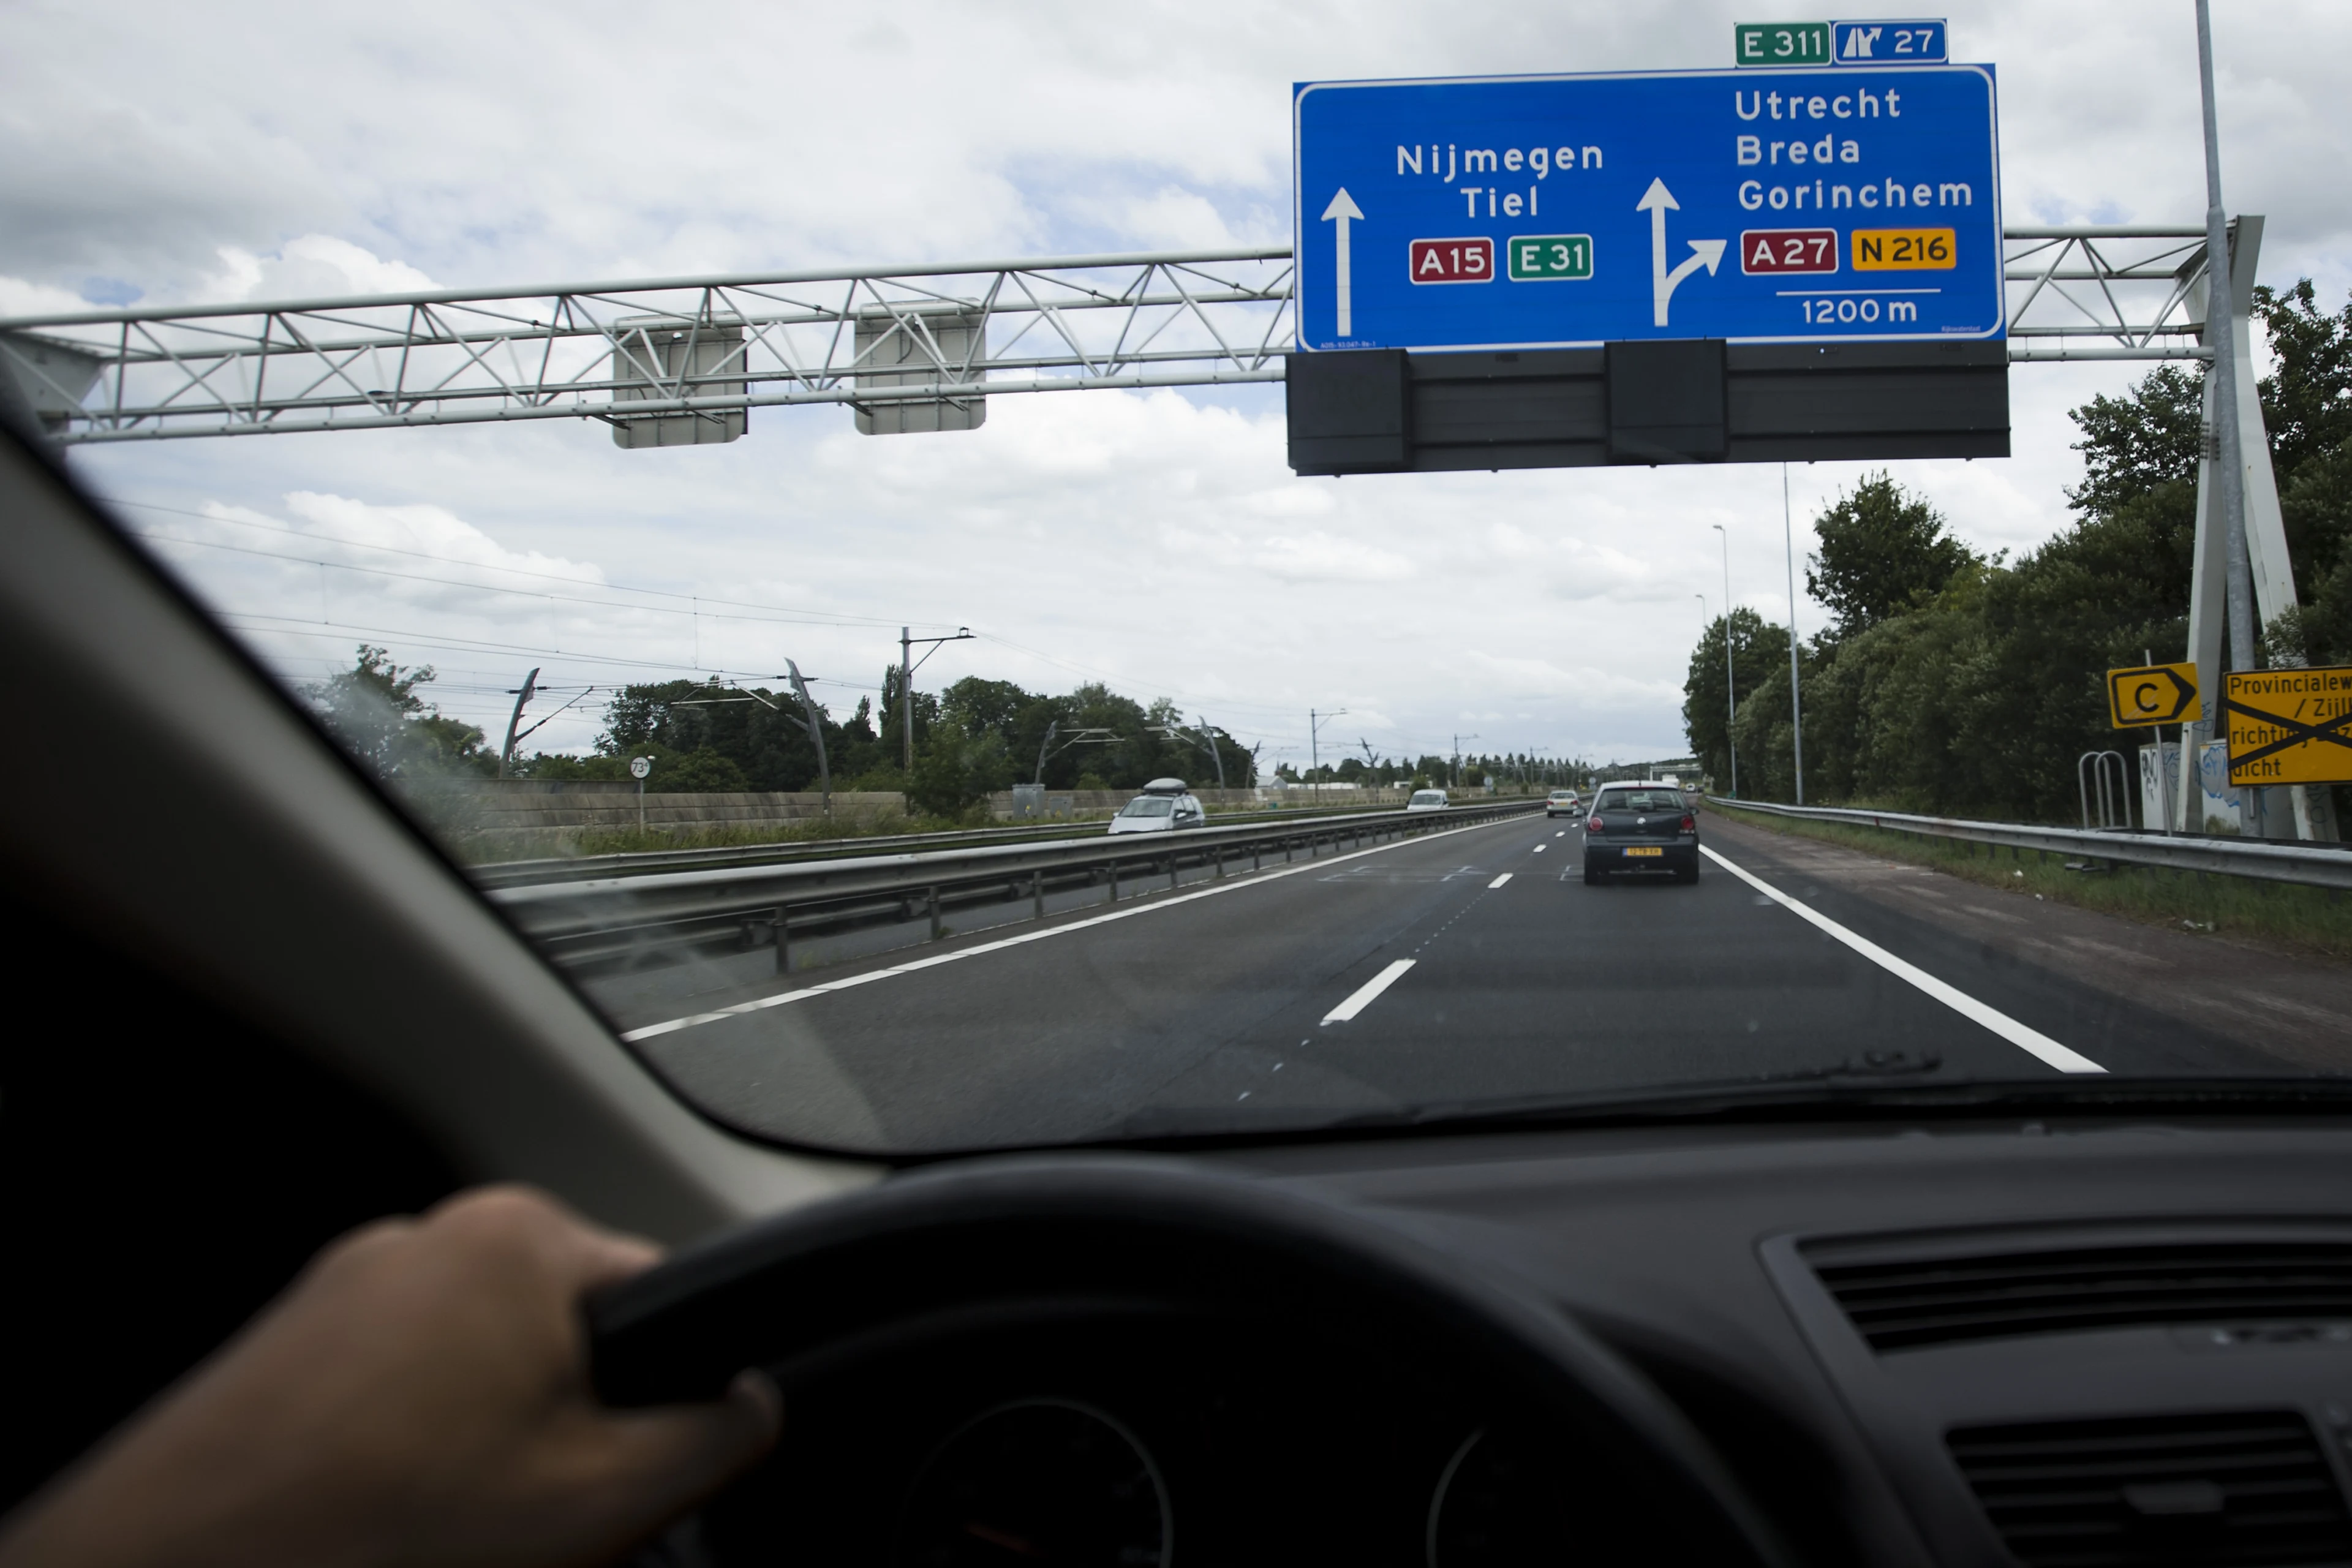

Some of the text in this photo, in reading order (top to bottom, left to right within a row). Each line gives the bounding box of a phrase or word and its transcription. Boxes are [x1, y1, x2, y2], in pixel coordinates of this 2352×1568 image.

[1744, 31, 1821, 56] E 311
[1895, 30, 1933, 53] 27
[1736, 88, 1900, 120] Utrecht
[1397, 144, 1602, 183] Nijmegen
[1737, 134, 1859, 165] Breda
[1460, 186, 1537, 217] Tiel
[1739, 178, 1972, 210] Gorinchem
[1803, 299, 1917, 323] 1200 m
[2135, 683, 2159, 712] C
[2231, 673, 2352, 695] Provincialew
[2233, 758, 2282, 777] dicht
